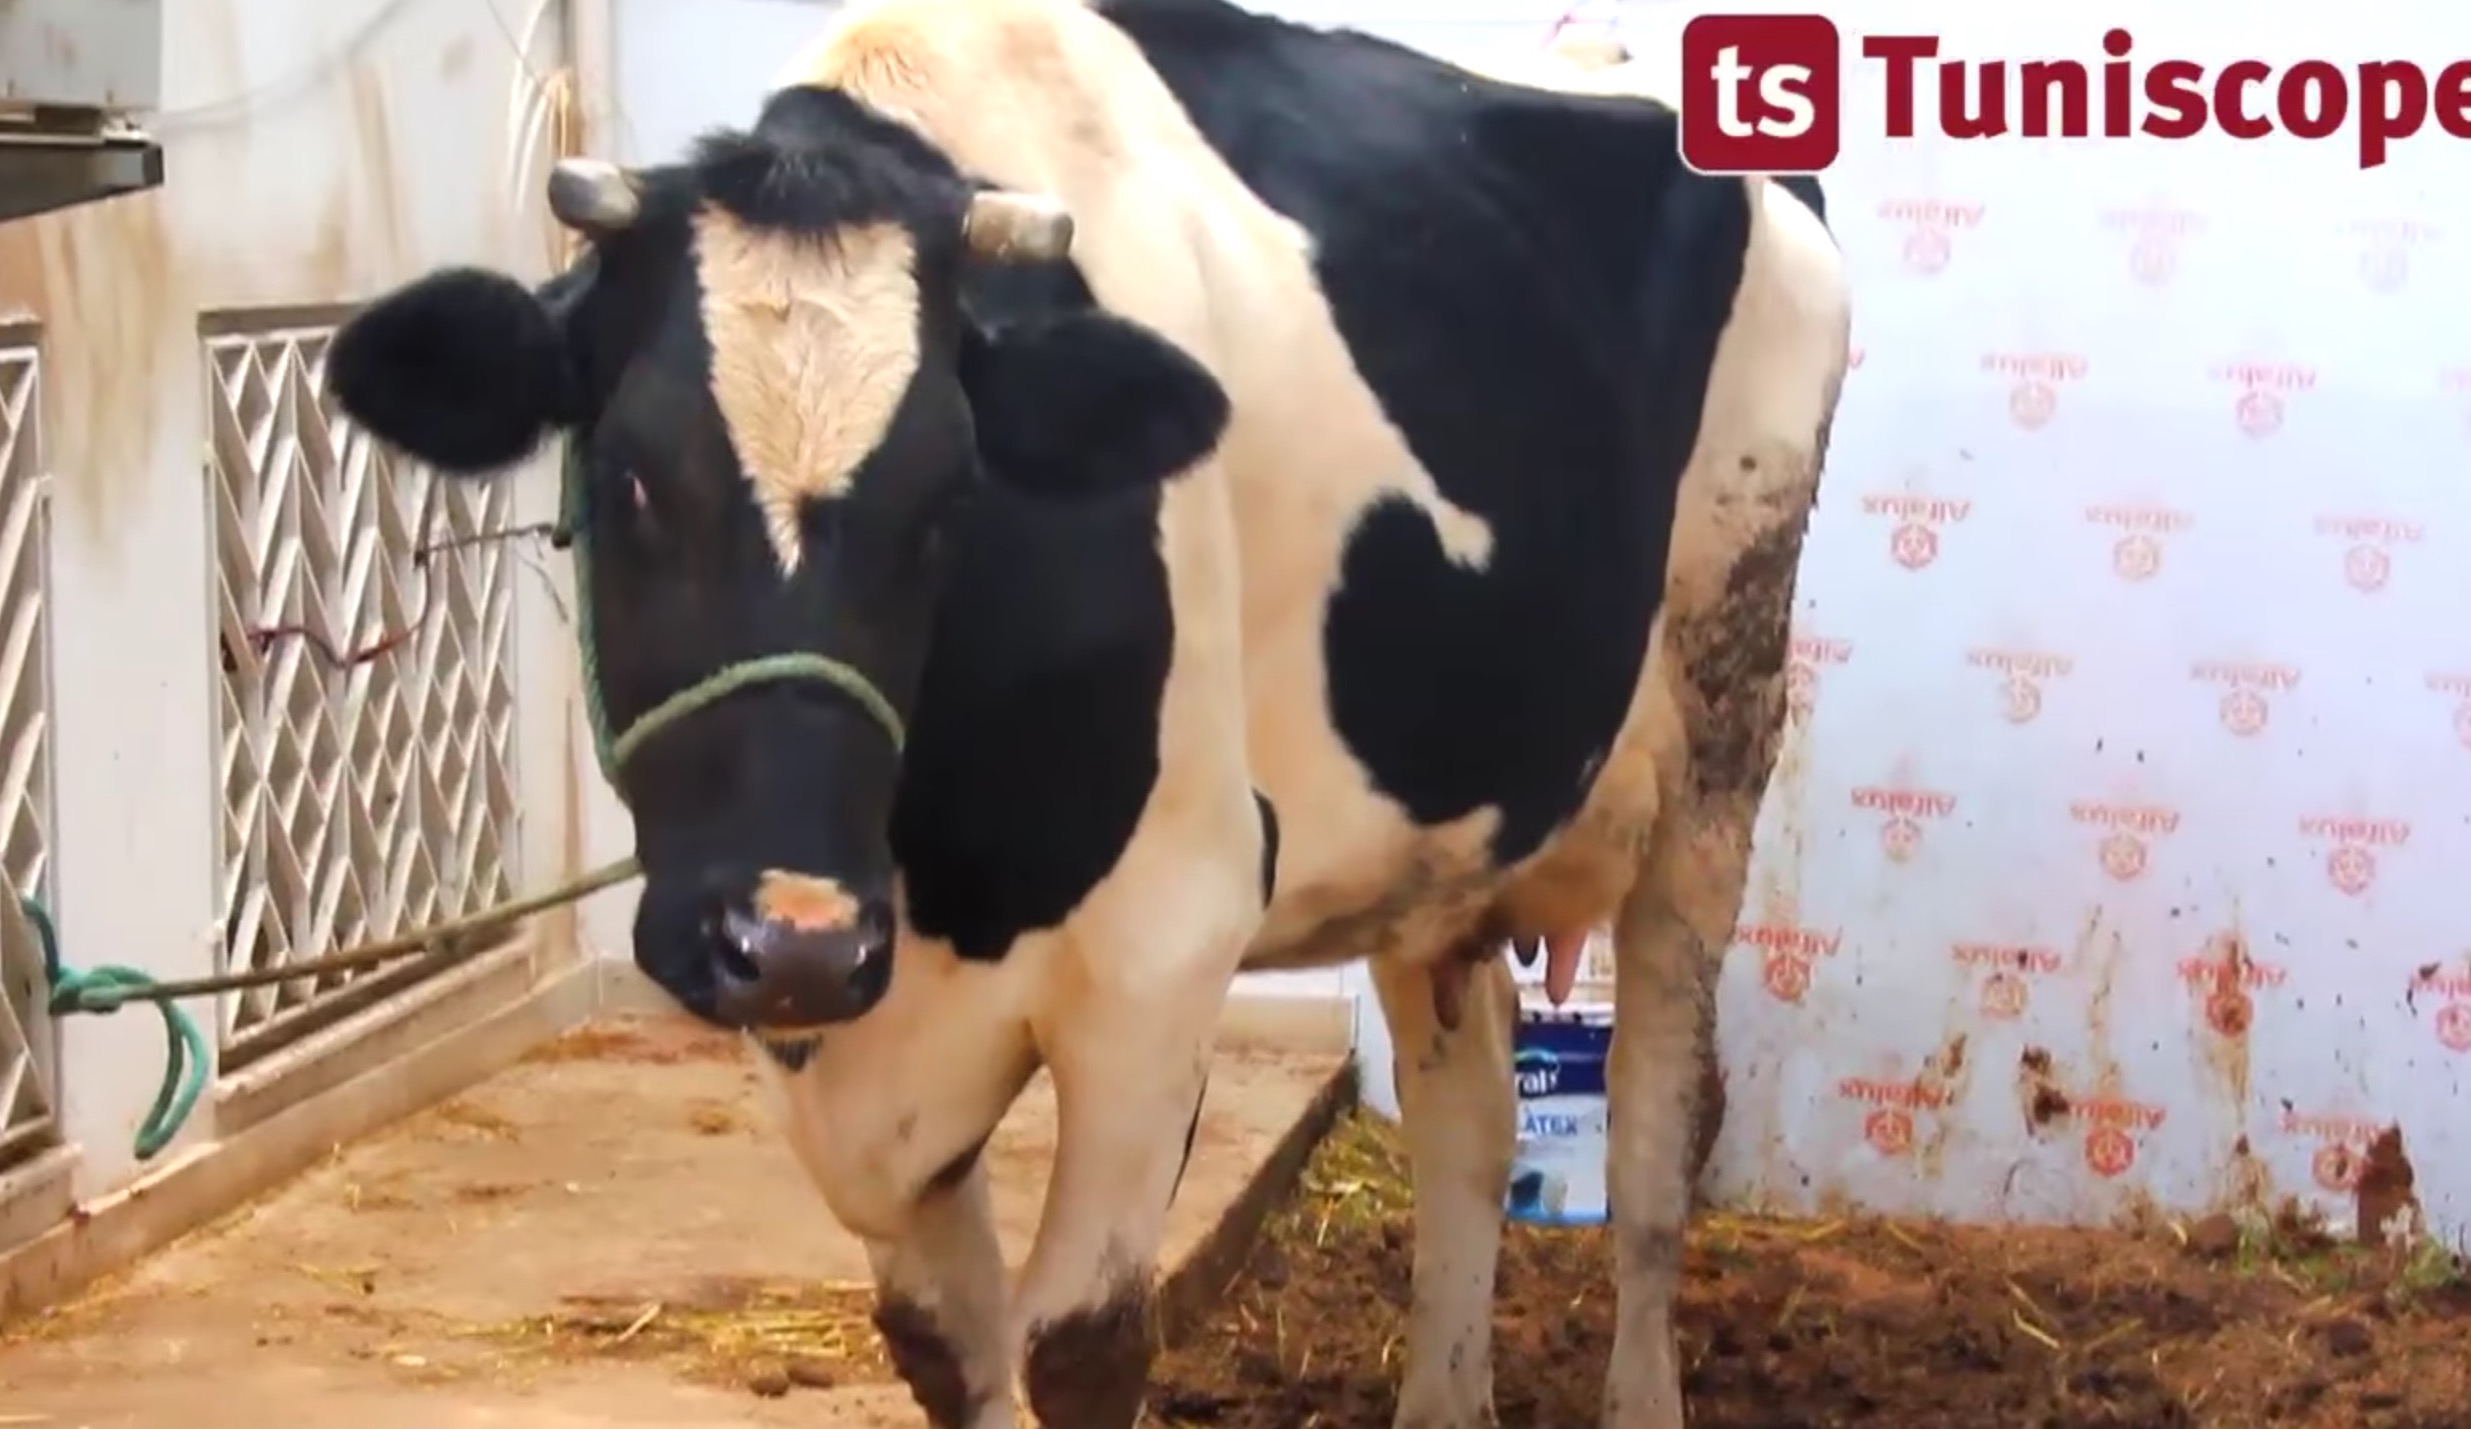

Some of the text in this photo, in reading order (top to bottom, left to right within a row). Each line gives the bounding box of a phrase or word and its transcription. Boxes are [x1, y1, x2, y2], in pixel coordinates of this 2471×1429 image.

[1861, 496, 1971, 522] Alfalux
[1851, 788, 1956, 818] Alfalux
[2070, 801, 2180, 833] Alfalux
[2299, 815, 2411, 845] Alfalux
[1736, 925, 1842, 957] Alfalux
[1514, 1069, 1550, 1093] ral
[1525, 1114, 1578, 1136] ATEX
